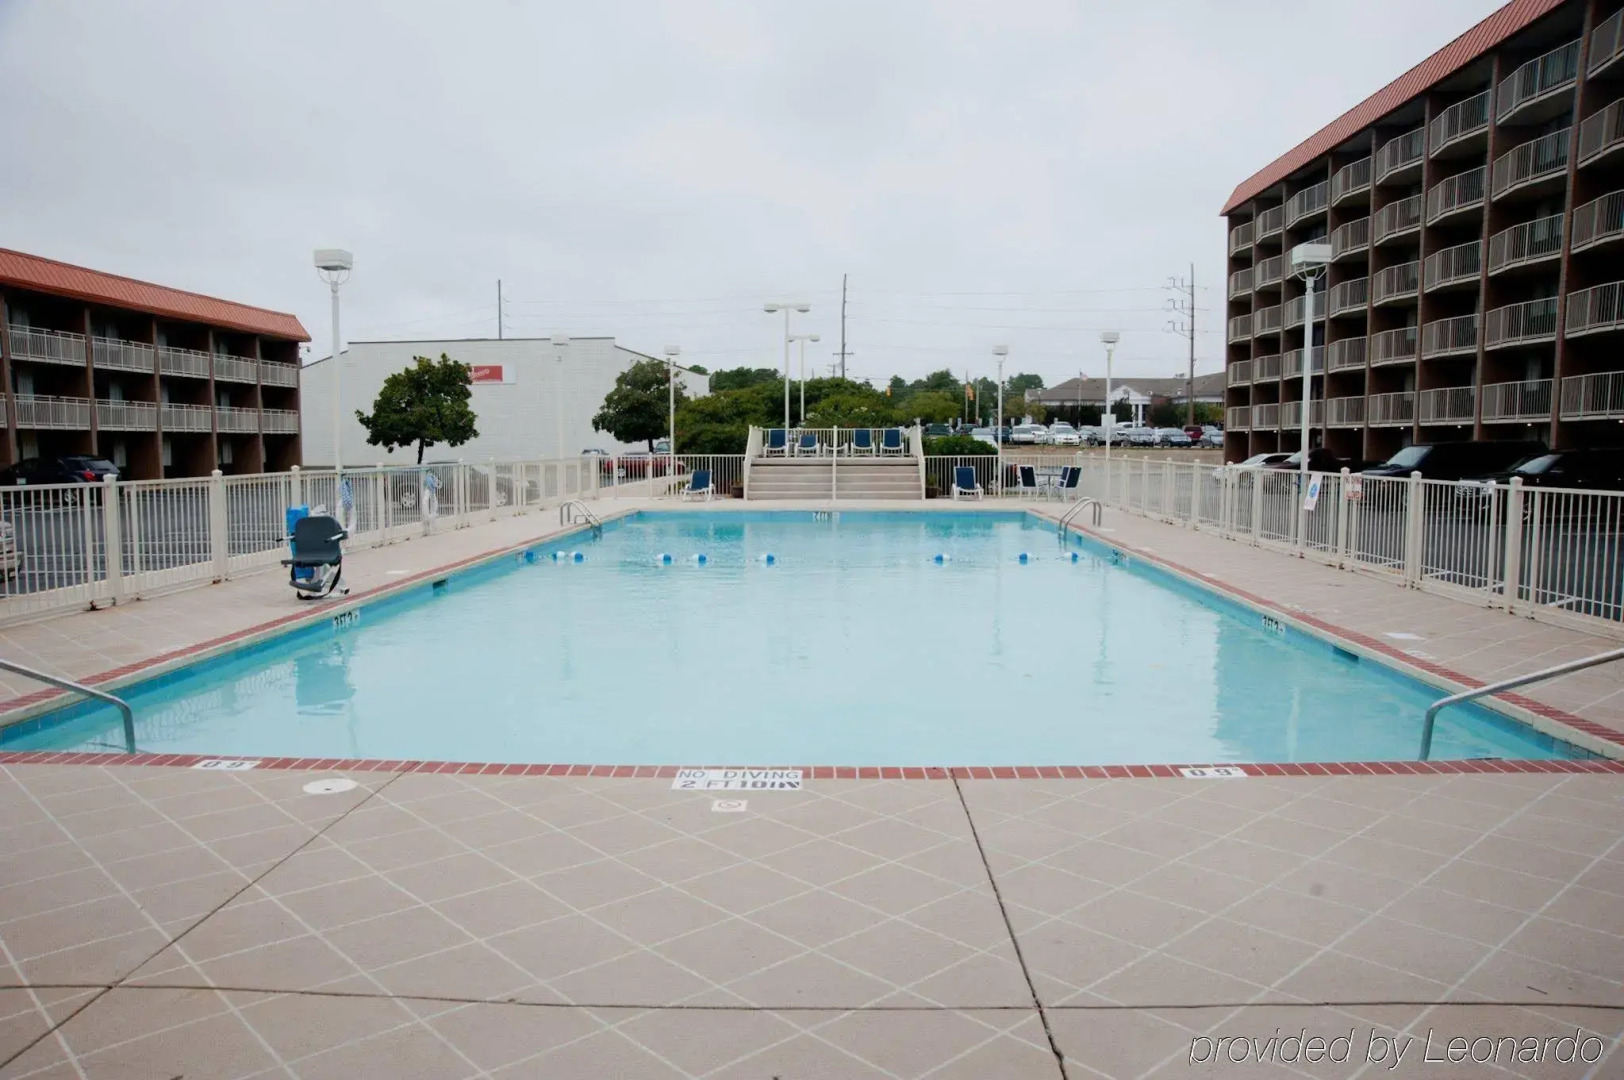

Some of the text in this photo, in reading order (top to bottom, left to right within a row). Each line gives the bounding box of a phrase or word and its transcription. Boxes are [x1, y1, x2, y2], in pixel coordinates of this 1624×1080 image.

[679, 770, 799, 779] NO DIVING
[681, 780, 697, 789] 2
